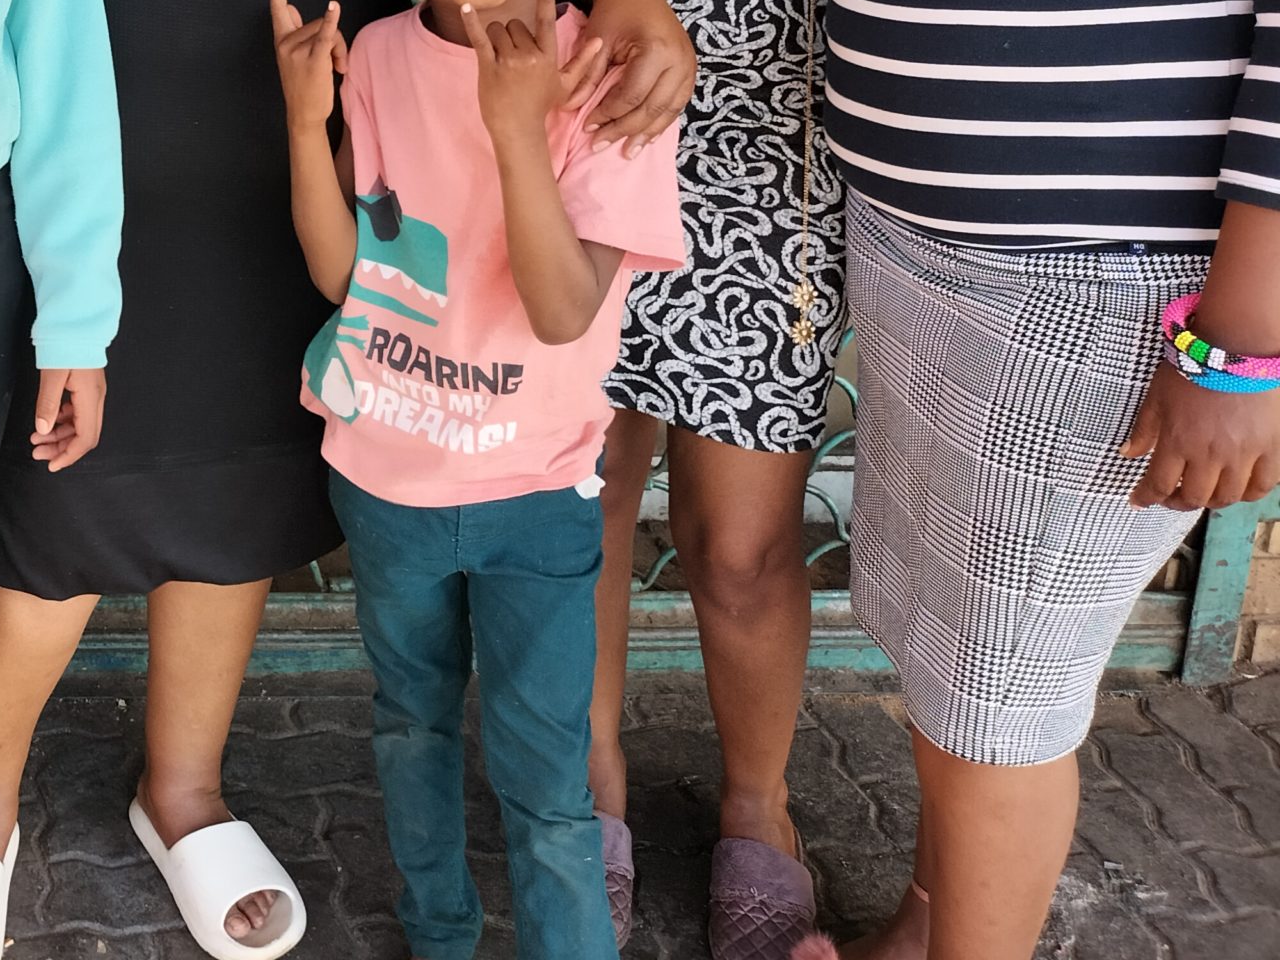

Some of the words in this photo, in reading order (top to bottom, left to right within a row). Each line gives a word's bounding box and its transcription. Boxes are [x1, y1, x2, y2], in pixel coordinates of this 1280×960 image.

[366, 326, 524, 397] ROARING
[382, 370, 441, 407] INTO
[448, 393, 492, 422] MY
[354, 379, 518, 455] DREAMS!
